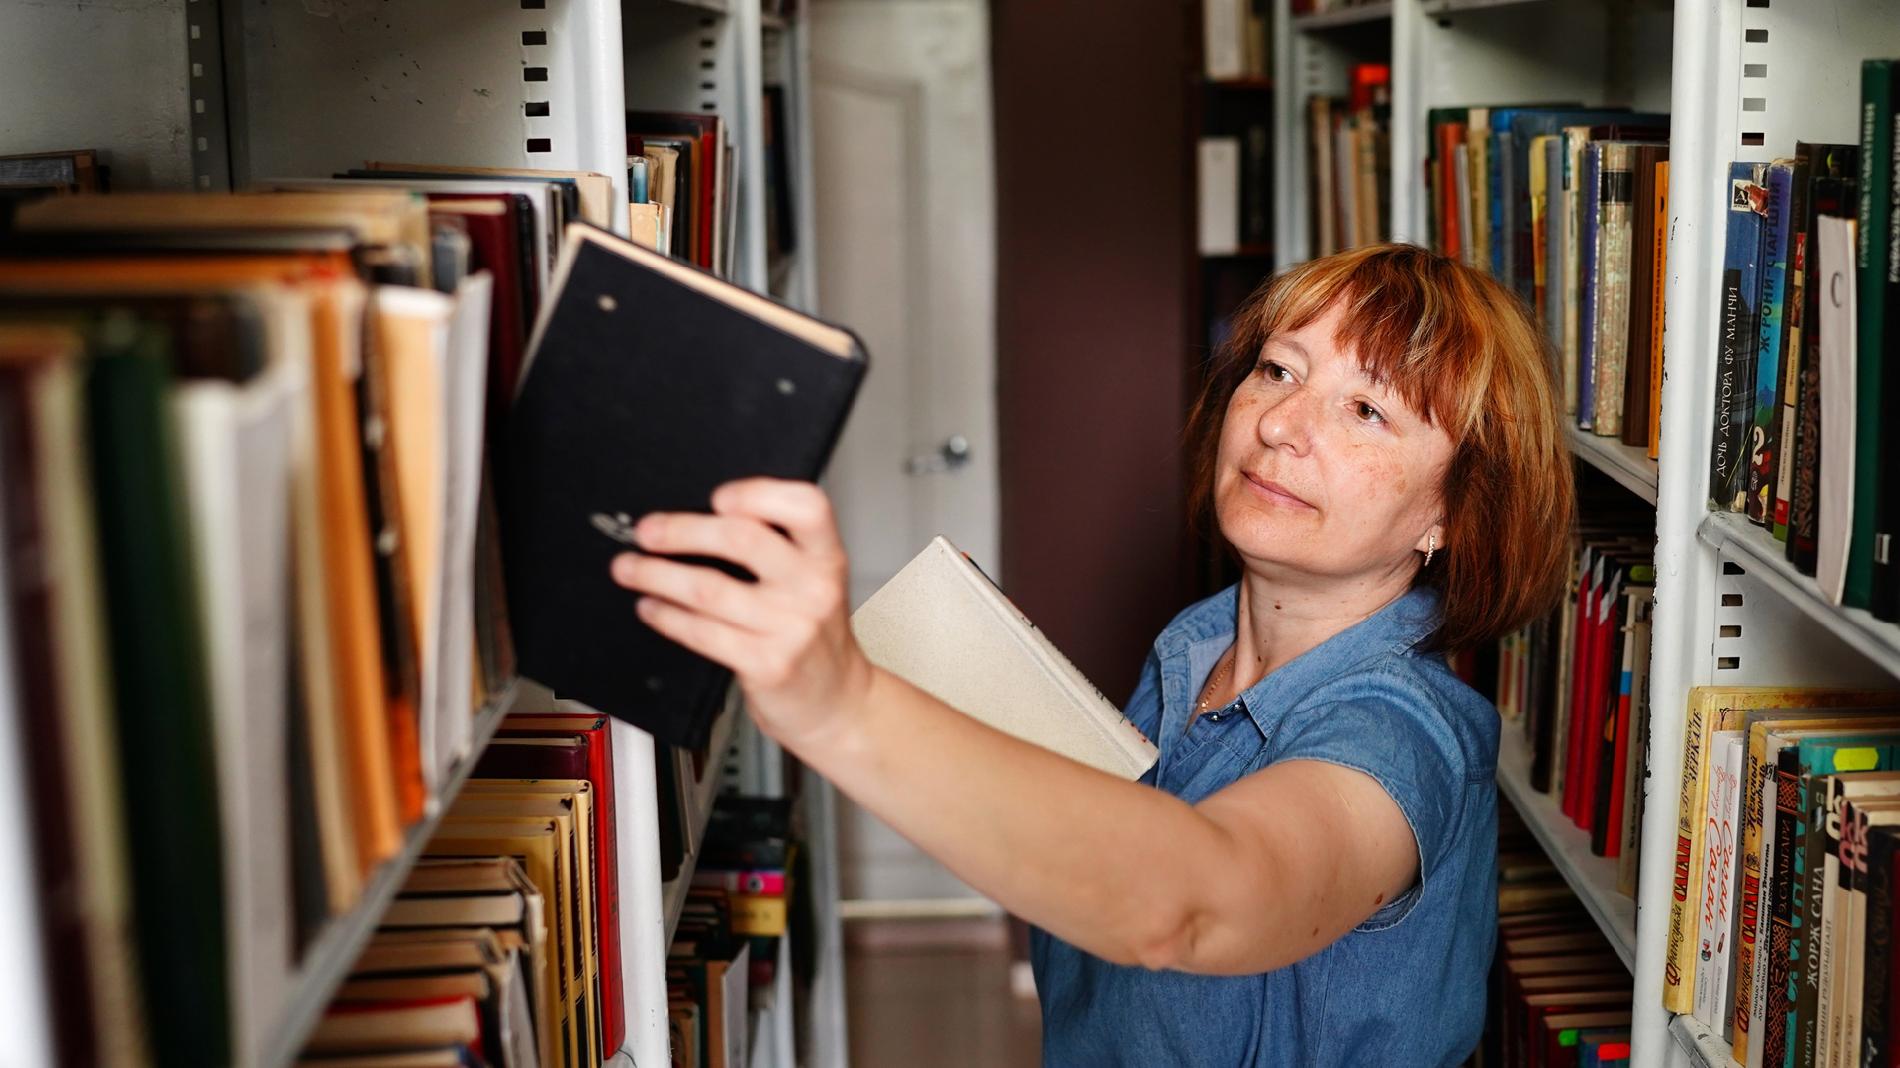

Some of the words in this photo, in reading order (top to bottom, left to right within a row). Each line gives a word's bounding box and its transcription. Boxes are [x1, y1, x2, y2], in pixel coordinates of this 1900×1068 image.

[1726, 286, 1738, 340] МАНЧИ
[1726, 345, 1734, 365] ФУ
[1719, 371, 1733, 437] ДОКТОРА
[1716, 439, 1728, 478] ДОЧЬ
[1689, 708, 1702, 787] ЗЕРКАЛЕ
[1747, 755, 1758, 838] Неясный
[1673, 834, 1691, 902] САГАН
[1705, 817, 1721, 931] Саган
[1718, 820, 1733, 923] Саган
[1742, 873, 1760, 944] САГАН
[1665, 904, 1684, 987] Франсуаза
[1807, 923, 1821, 990] ЖОРЖ
[1736, 946, 1751, 1034] Франсуаза
